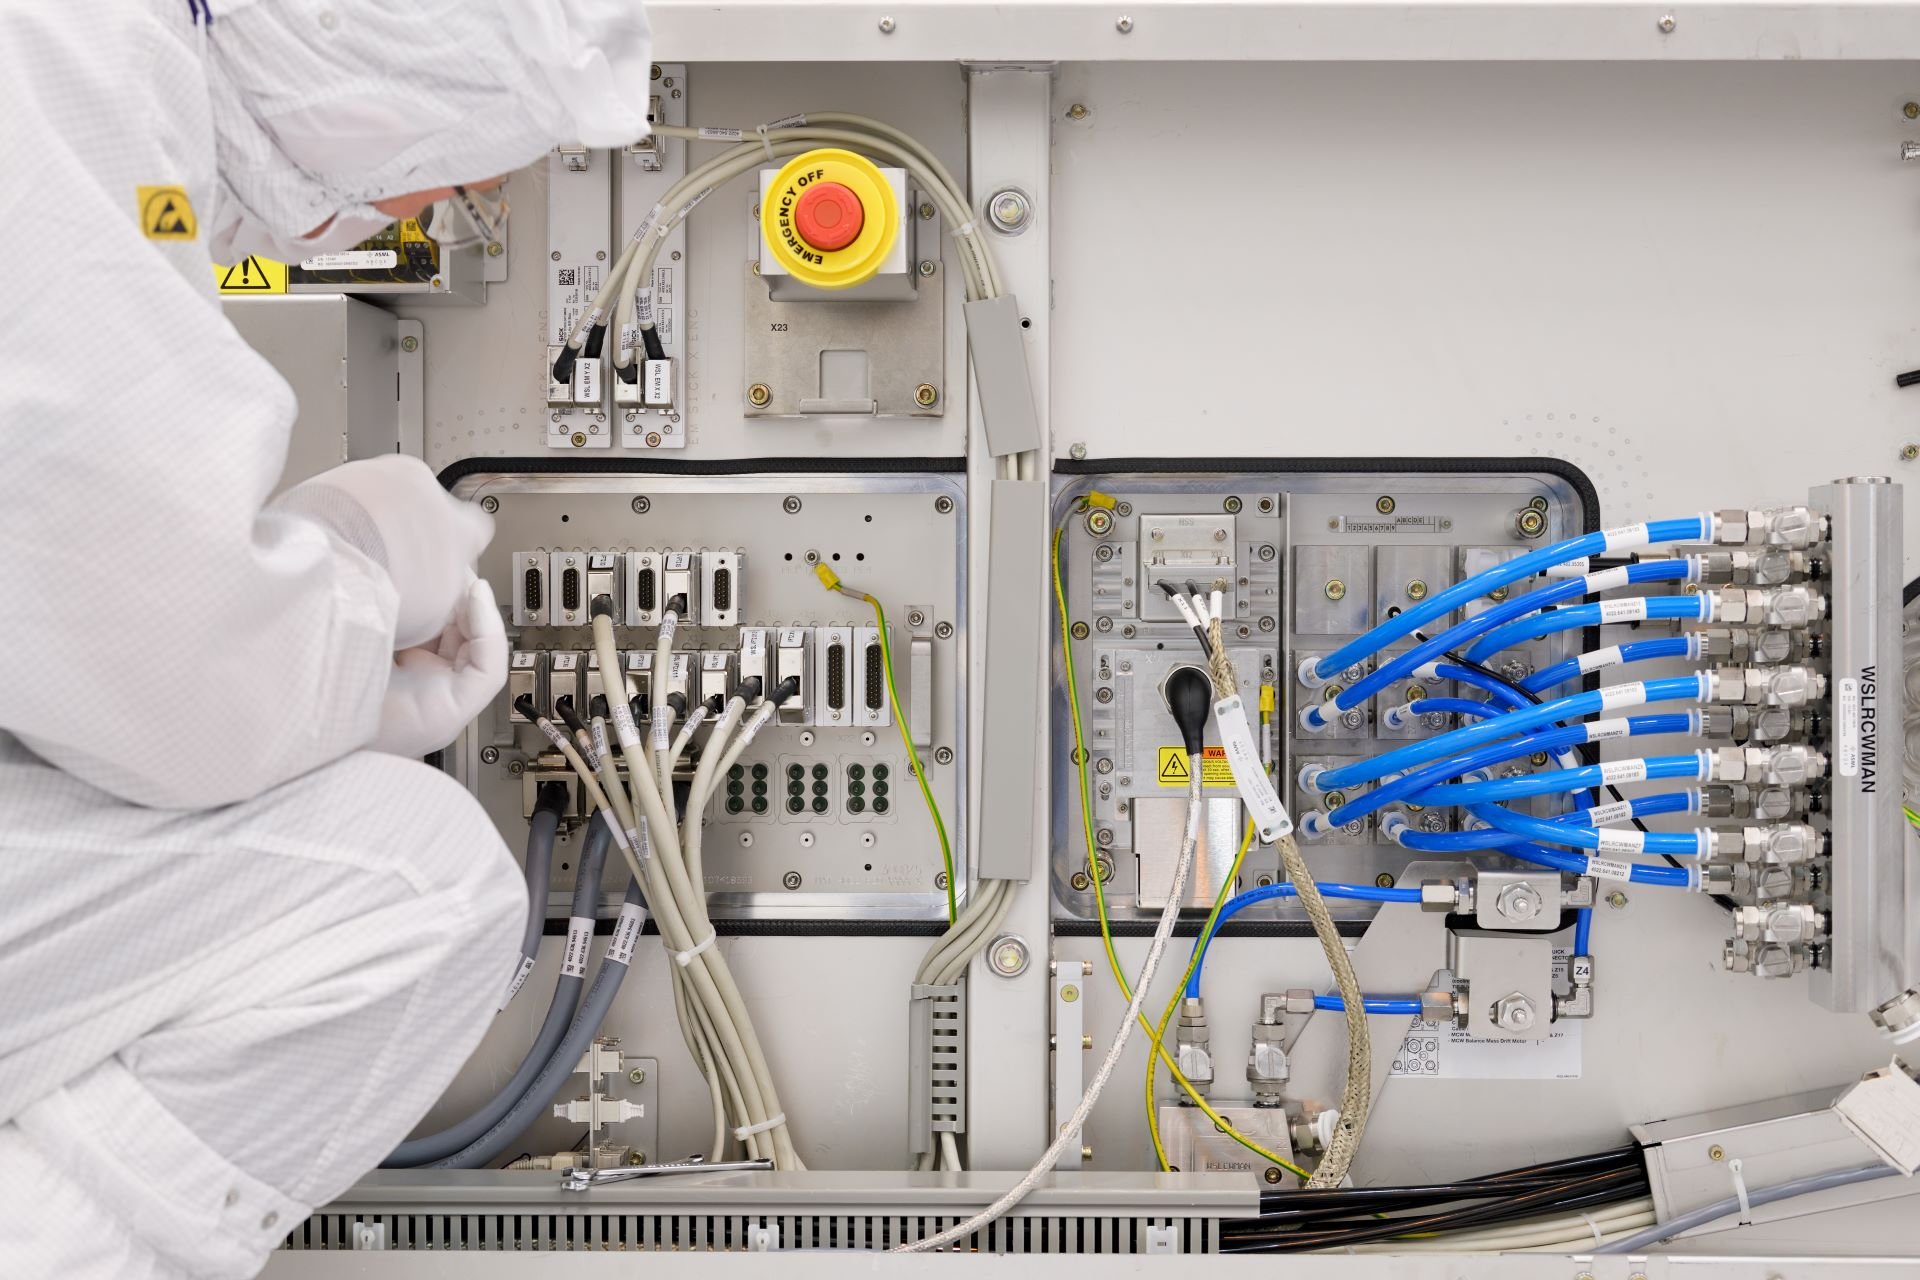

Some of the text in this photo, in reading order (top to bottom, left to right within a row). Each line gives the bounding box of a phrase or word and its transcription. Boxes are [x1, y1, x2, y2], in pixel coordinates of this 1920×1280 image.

[780, 169, 824, 264] EMERGENCY OFF
[654, 363, 662, 376] WSL
[583, 375, 591, 385] EM
[654, 377, 661, 387] EM
[583, 386, 591, 399] WSL
[1861, 666, 1876, 793] WSLRCWMAN
[1576, 966, 1589, 975] Z4
